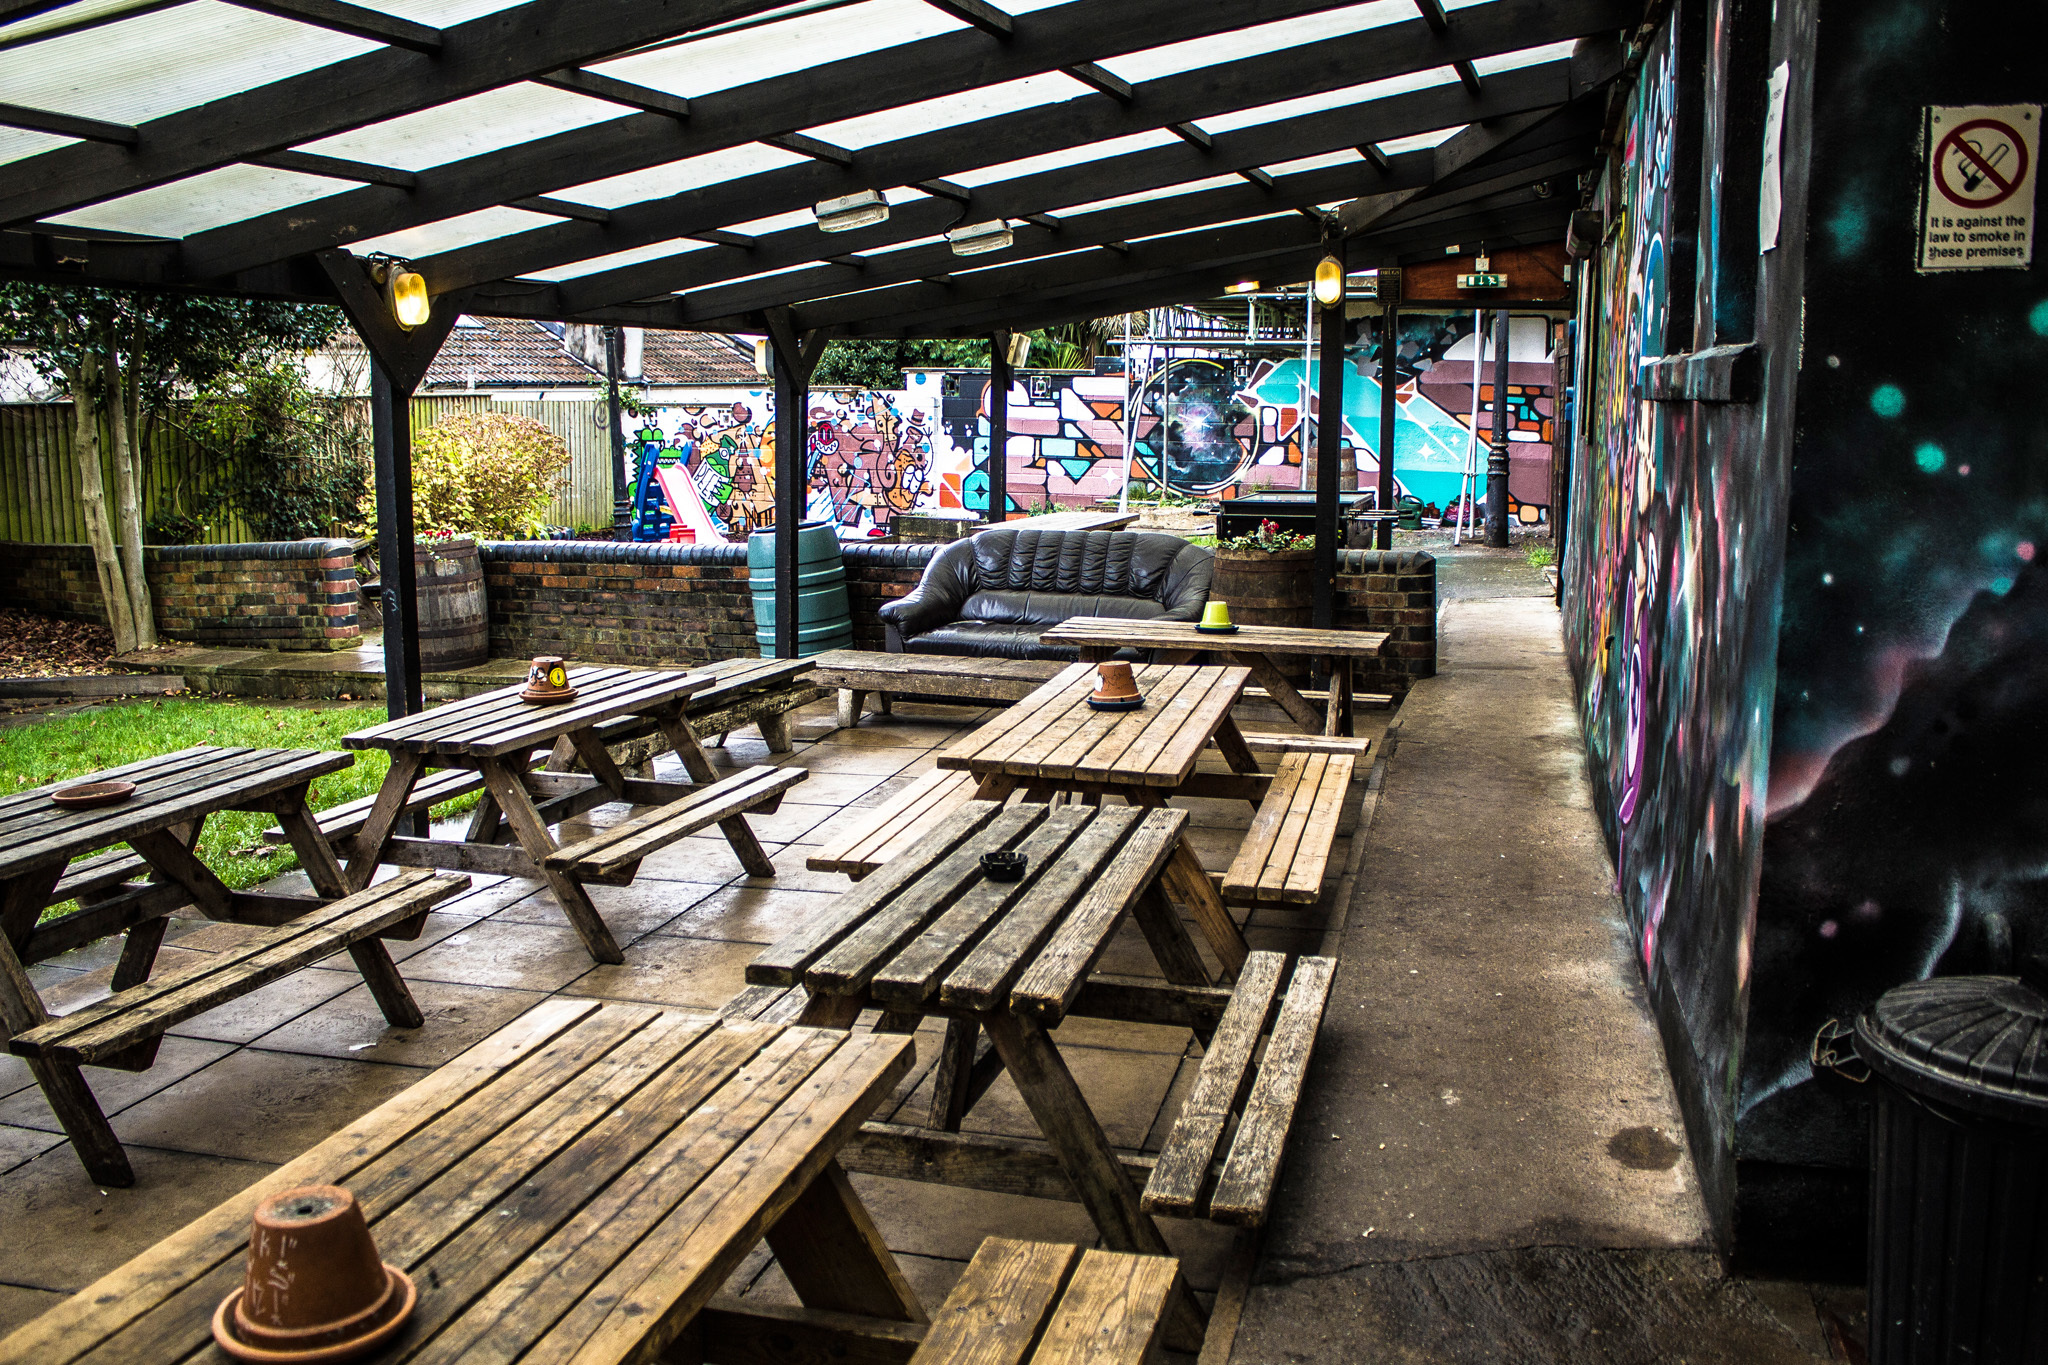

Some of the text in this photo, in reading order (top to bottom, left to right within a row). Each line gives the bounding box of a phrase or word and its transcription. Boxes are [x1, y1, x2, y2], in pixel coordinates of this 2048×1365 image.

[1931, 215, 2025, 230] It is against the
[1929, 230, 2025, 243] law to smoke in
[1928, 245, 2024, 260] these premises
